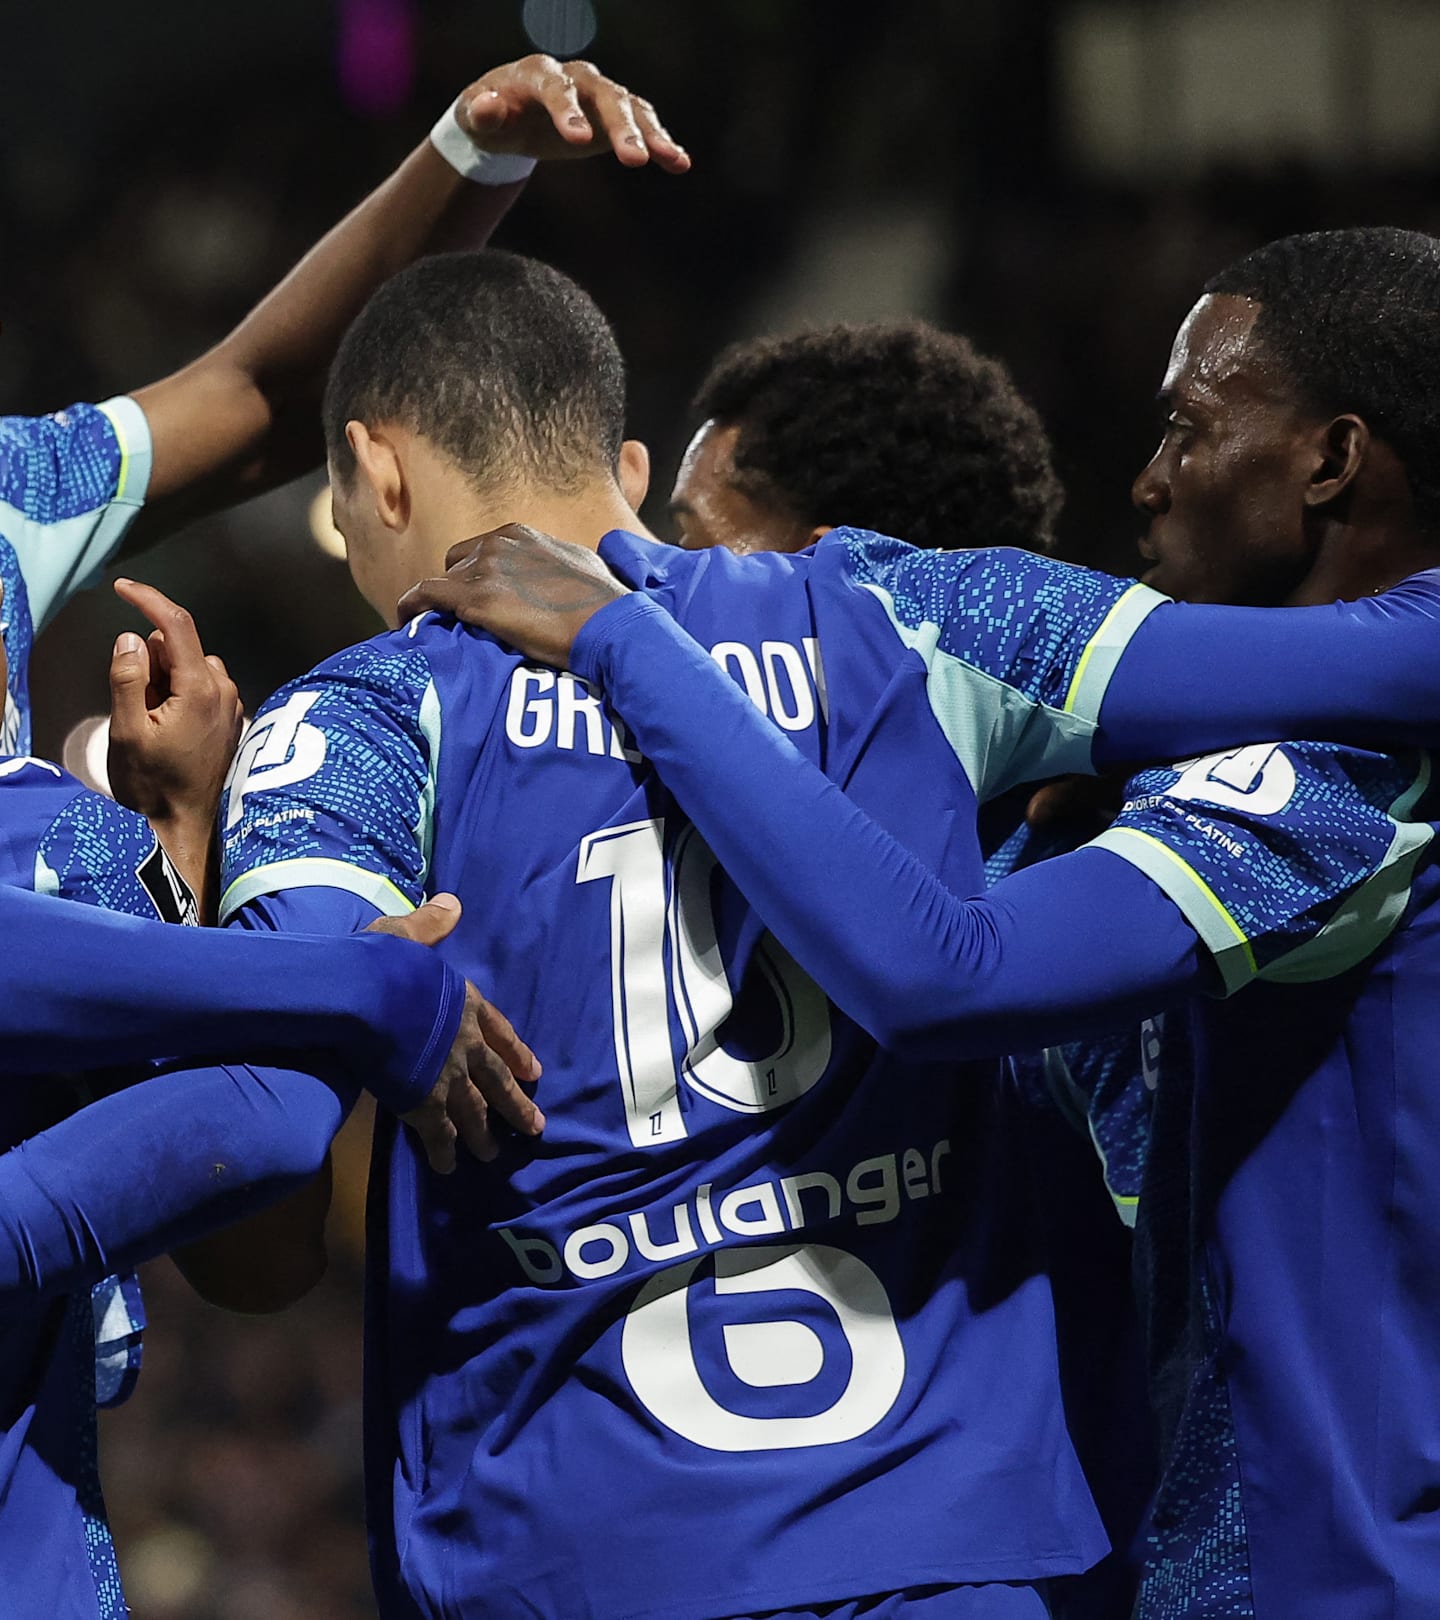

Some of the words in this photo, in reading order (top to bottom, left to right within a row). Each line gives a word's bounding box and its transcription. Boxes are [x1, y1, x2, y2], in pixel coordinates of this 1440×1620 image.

[254, 808, 316, 828] PLATINE
[1184, 814, 1245, 858] PLATINE
[496, 1139, 952, 1285] boulanger
